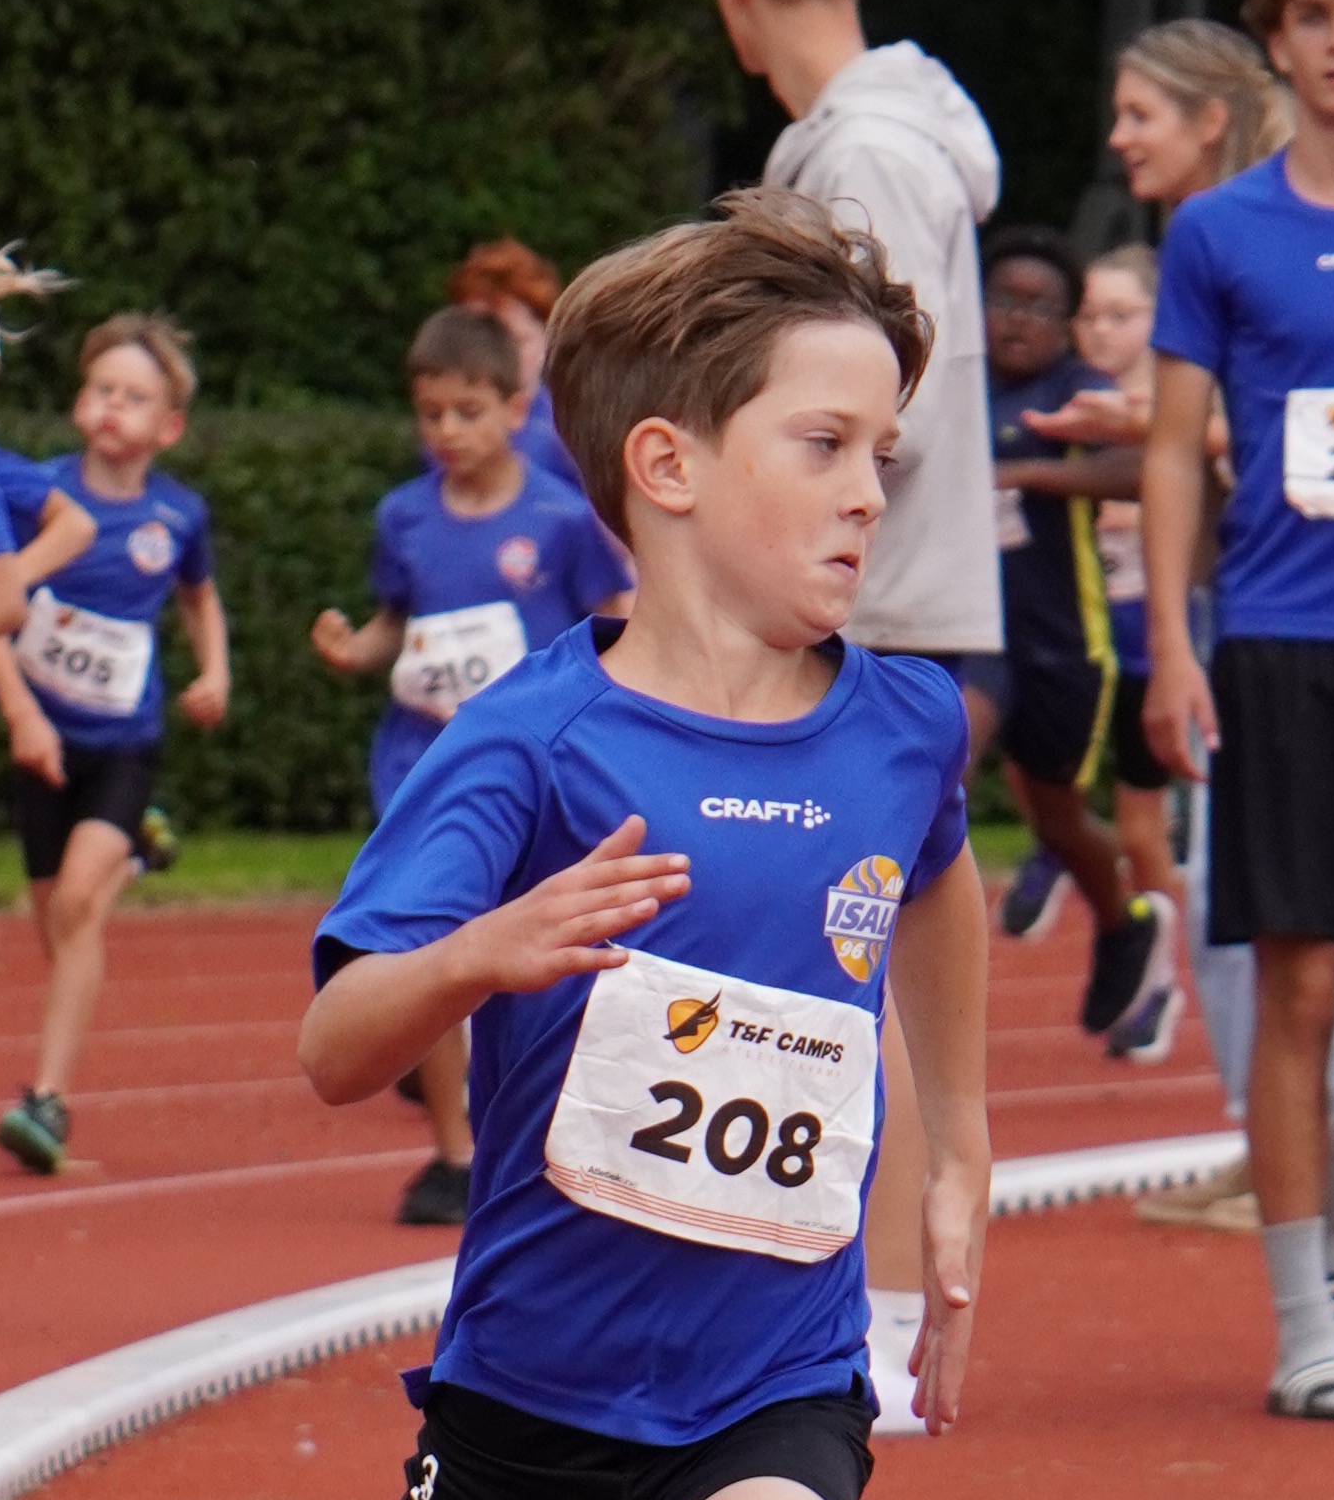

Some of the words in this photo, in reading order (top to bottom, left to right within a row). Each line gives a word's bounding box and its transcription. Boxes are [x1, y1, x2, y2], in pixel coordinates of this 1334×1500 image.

[42, 636, 113, 684] 205
[421, 656, 488, 695] 210
[700, 797, 802, 823] CRAFT
[827, 898, 896, 936] ISAL
[838, 940, 866, 960] 96
[729, 1019, 774, 1045] T&F
[776, 1032, 844, 1063] CAMPS
[629, 1080, 822, 1188] 208
